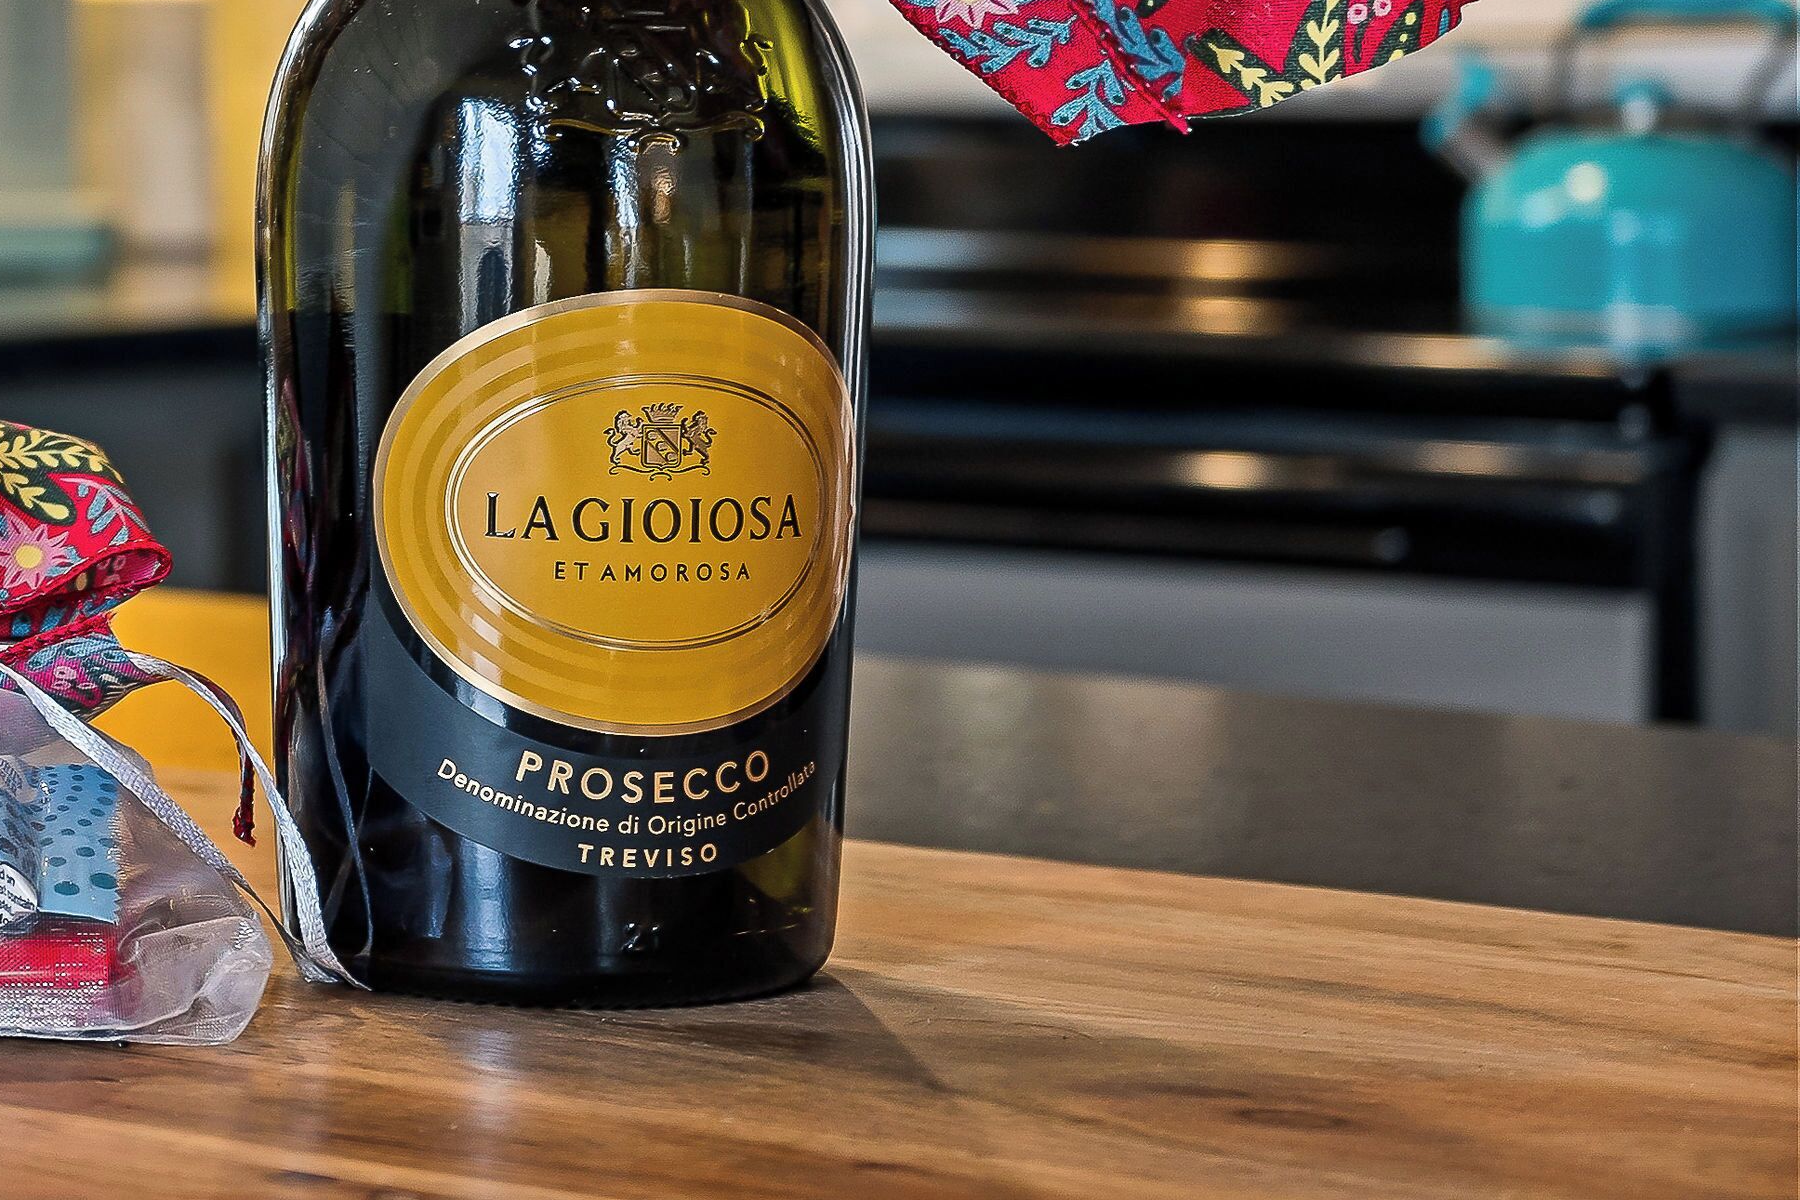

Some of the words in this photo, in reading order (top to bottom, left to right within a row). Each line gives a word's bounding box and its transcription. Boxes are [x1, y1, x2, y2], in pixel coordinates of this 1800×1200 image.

[485, 492, 558, 541] LA
[572, 494, 803, 543] GIOIOSA
[555, 561, 590, 580] ET
[600, 562, 751, 582] AMOROSA
[437, 757, 610, 834] Denominazione
[618, 815, 640, 836] di
[648, 810, 727, 838] Origine
[733, 760, 817, 822] Controllata
[515, 749, 771, 804] PROSECCO
[577, 843, 718, 868] TREVISO
